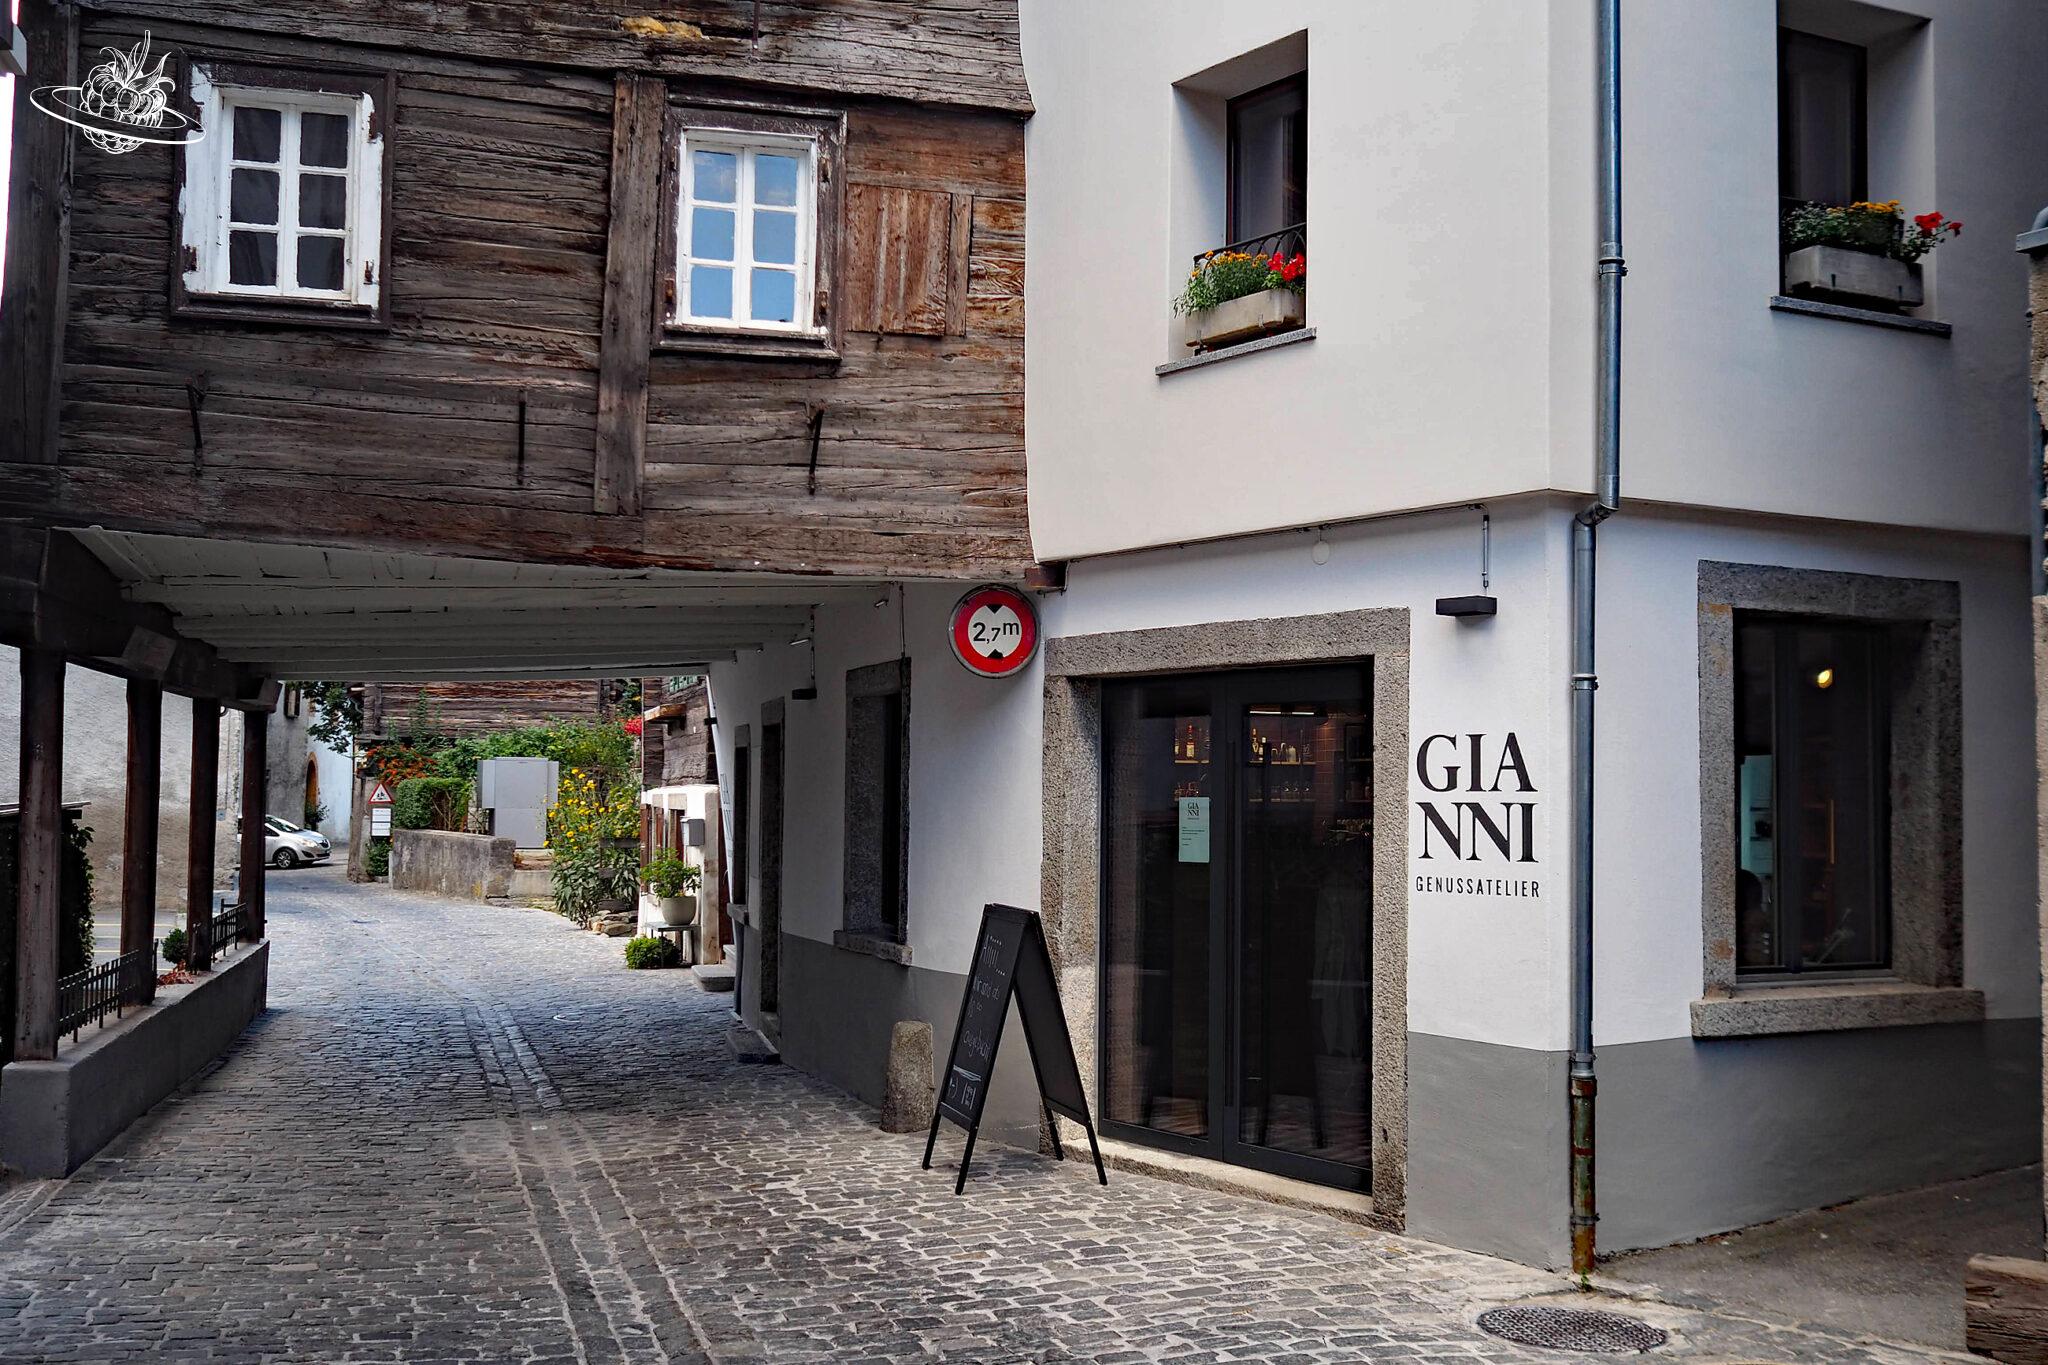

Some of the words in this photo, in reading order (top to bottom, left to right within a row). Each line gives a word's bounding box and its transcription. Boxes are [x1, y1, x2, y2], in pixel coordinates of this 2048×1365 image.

[1416, 732, 1538, 792] GIA
[1415, 802, 1539, 862] NNI
[1415, 876, 1540, 898] GENUSSATELIER
